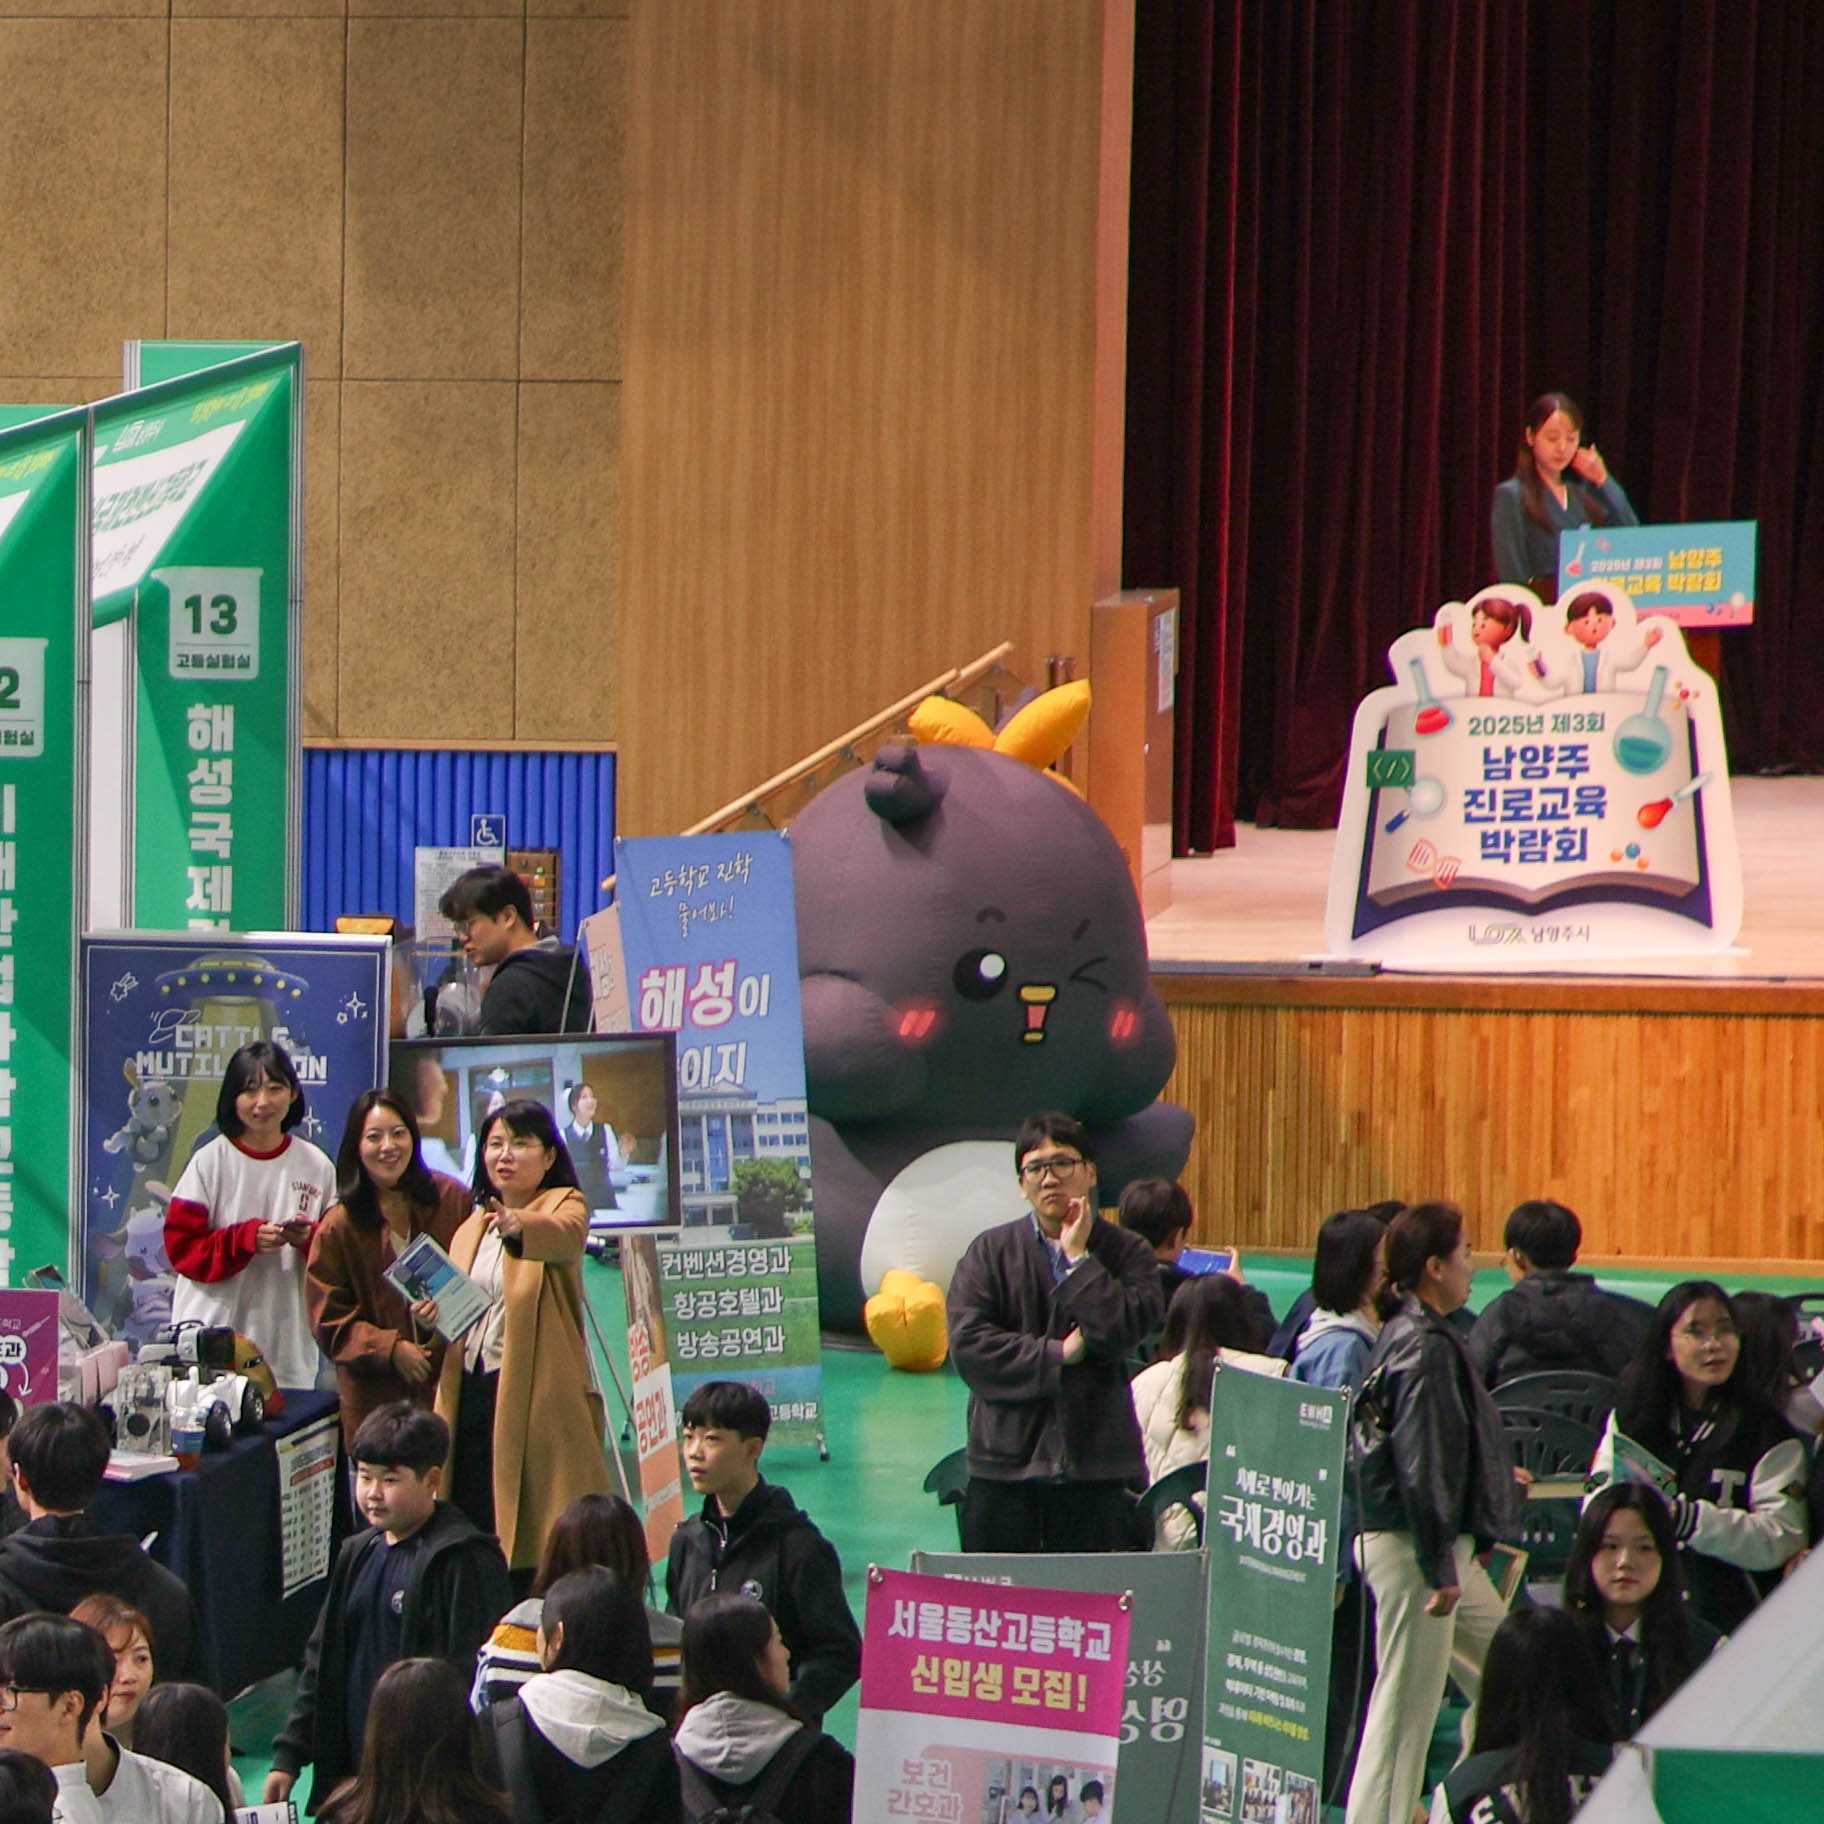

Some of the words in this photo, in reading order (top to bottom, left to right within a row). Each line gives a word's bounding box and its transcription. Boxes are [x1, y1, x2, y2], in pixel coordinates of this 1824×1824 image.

[184, 594, 237, 636] 13
[1468, 714, 1544, 735] 2025년
[1551, 713, 1606, 734] 제3회
[1482, 745, 1590, 781] 남양주
[1463, 785, 1608, 824] 진로교육
[1480, 825, 1588, 863] 박람회
[650, 863, 710, 897] 고등학교
[717, 853, 754, 884] 진학
[1531, 925, 1591, 944] 남양주시
[639, 959, 771, 1031] 해성이
[662, 1246, 793, 1279] 컨벤션경영과
[674, 1287, 783, 1319] 항공호텔과
[677, 1326, 786, 1358] 방송공연과
[1219, 1495, 1327, 1564] 국제경영과
[888, 1600, 1111, 1661] 서울동산고등학교
[911, 1655, 1002, 1701] 신입생
[1011, 1667, 1087, 1713] 모집!
[902, 1759, 949, 1788] 보건
[888, 1789, 962, 1823] 간호과
